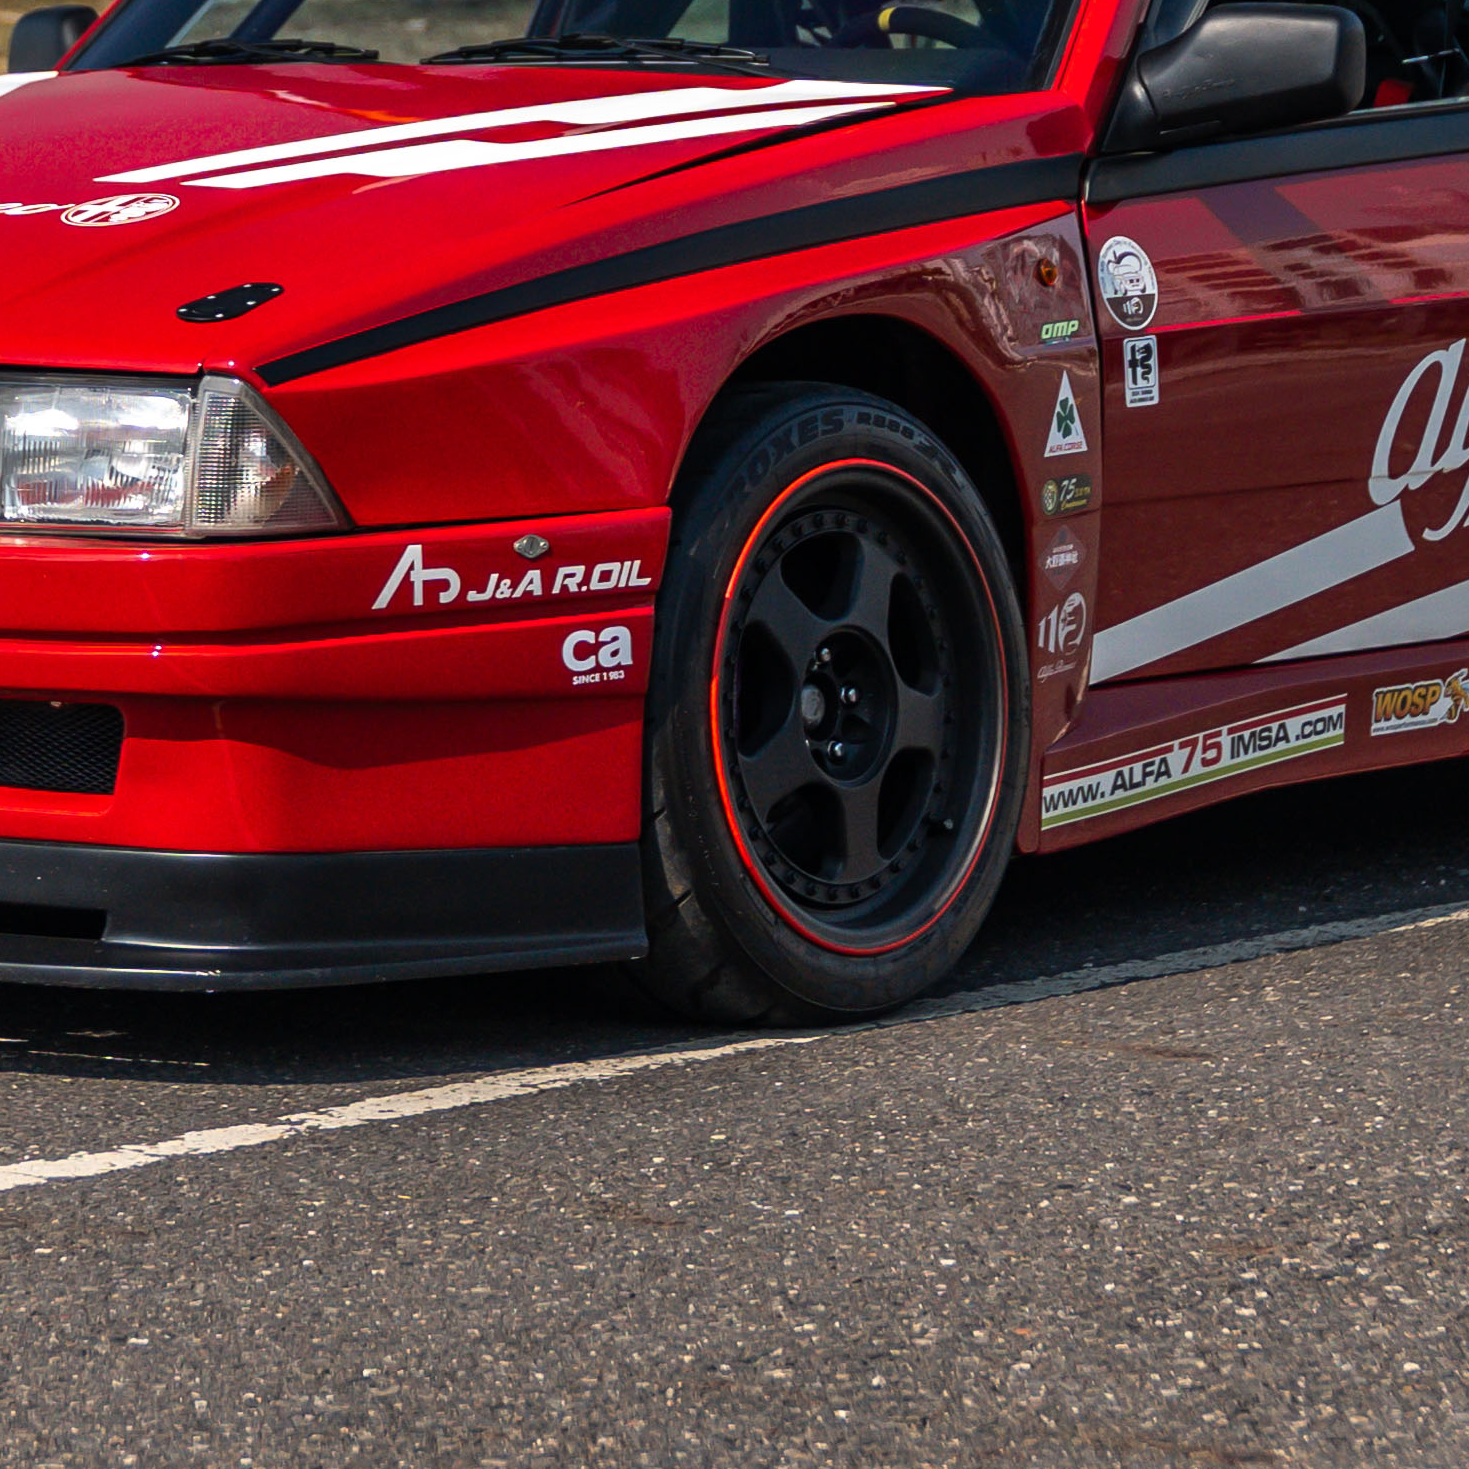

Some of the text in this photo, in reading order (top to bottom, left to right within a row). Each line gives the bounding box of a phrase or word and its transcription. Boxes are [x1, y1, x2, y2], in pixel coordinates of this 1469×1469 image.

[1041, 319, 1080, 340] OMP
[467, 559, 653, 603] J&A R.OIL
[561, 625, 634, 673] ca
[572, 672, 601, 687] SINCE
[1374, 683, 1442, 723] WOSP
[1110, 756, 1173, 796] ALFA
[1177, 730, 1223, 775] 75
[1230, 723, 1291, 760] IMSA
